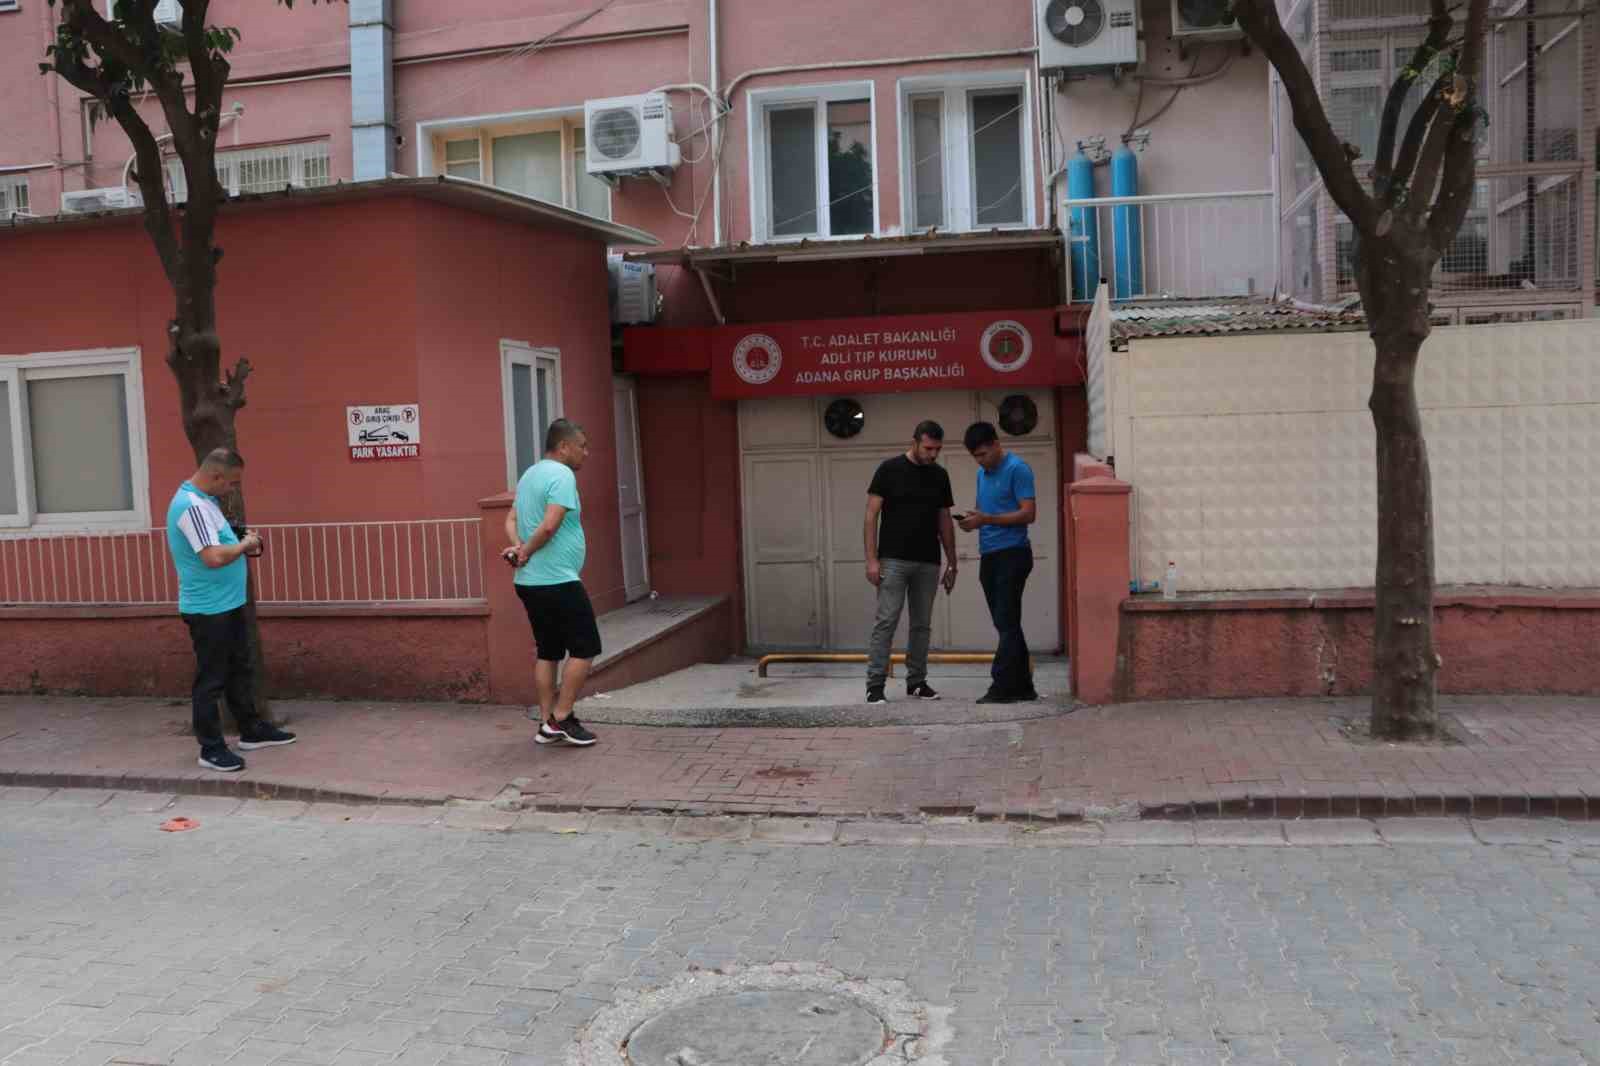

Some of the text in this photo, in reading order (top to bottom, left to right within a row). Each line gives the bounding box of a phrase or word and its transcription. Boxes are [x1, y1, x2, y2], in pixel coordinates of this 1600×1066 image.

[800, 327, 957, 348] T.C. ADALET BAKANLIĞI
[879, 348, 937, 362] KURUMU
[795, 363, 966, 384] ADANA GRUP BAŞKANLIĞI
[352, 446, 418, 458] PARK YASAKTIR
